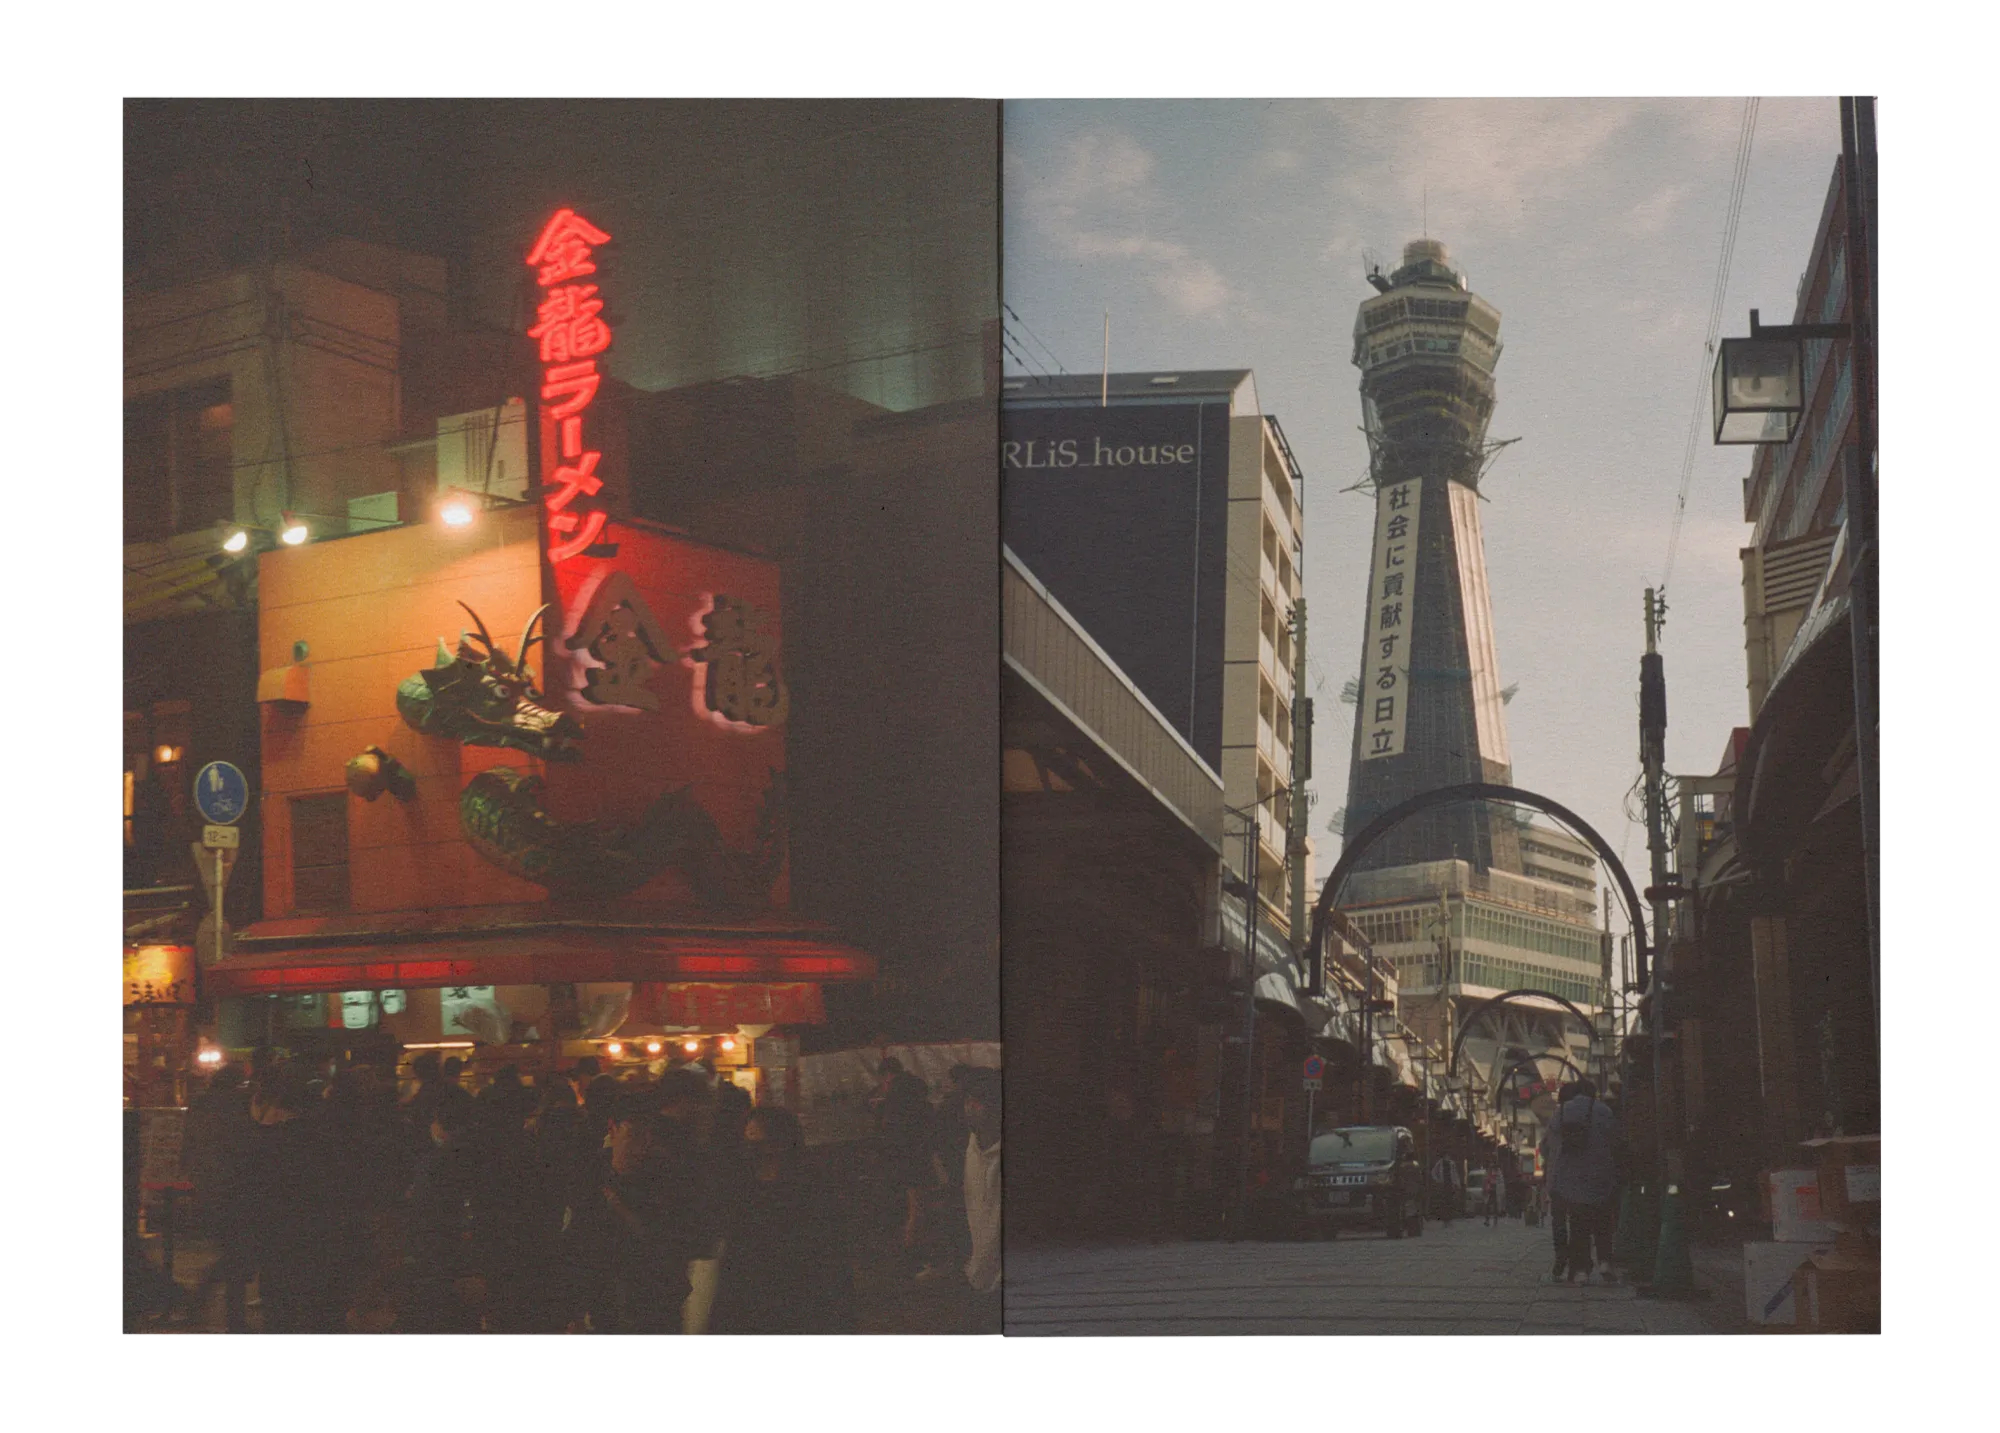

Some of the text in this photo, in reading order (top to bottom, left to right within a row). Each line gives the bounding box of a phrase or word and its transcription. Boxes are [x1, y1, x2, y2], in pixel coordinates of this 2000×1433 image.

[526, 206, 612, 564] 金龍ラーメン
[1370, 484, 1411, 755] 社会に貢献する日立
